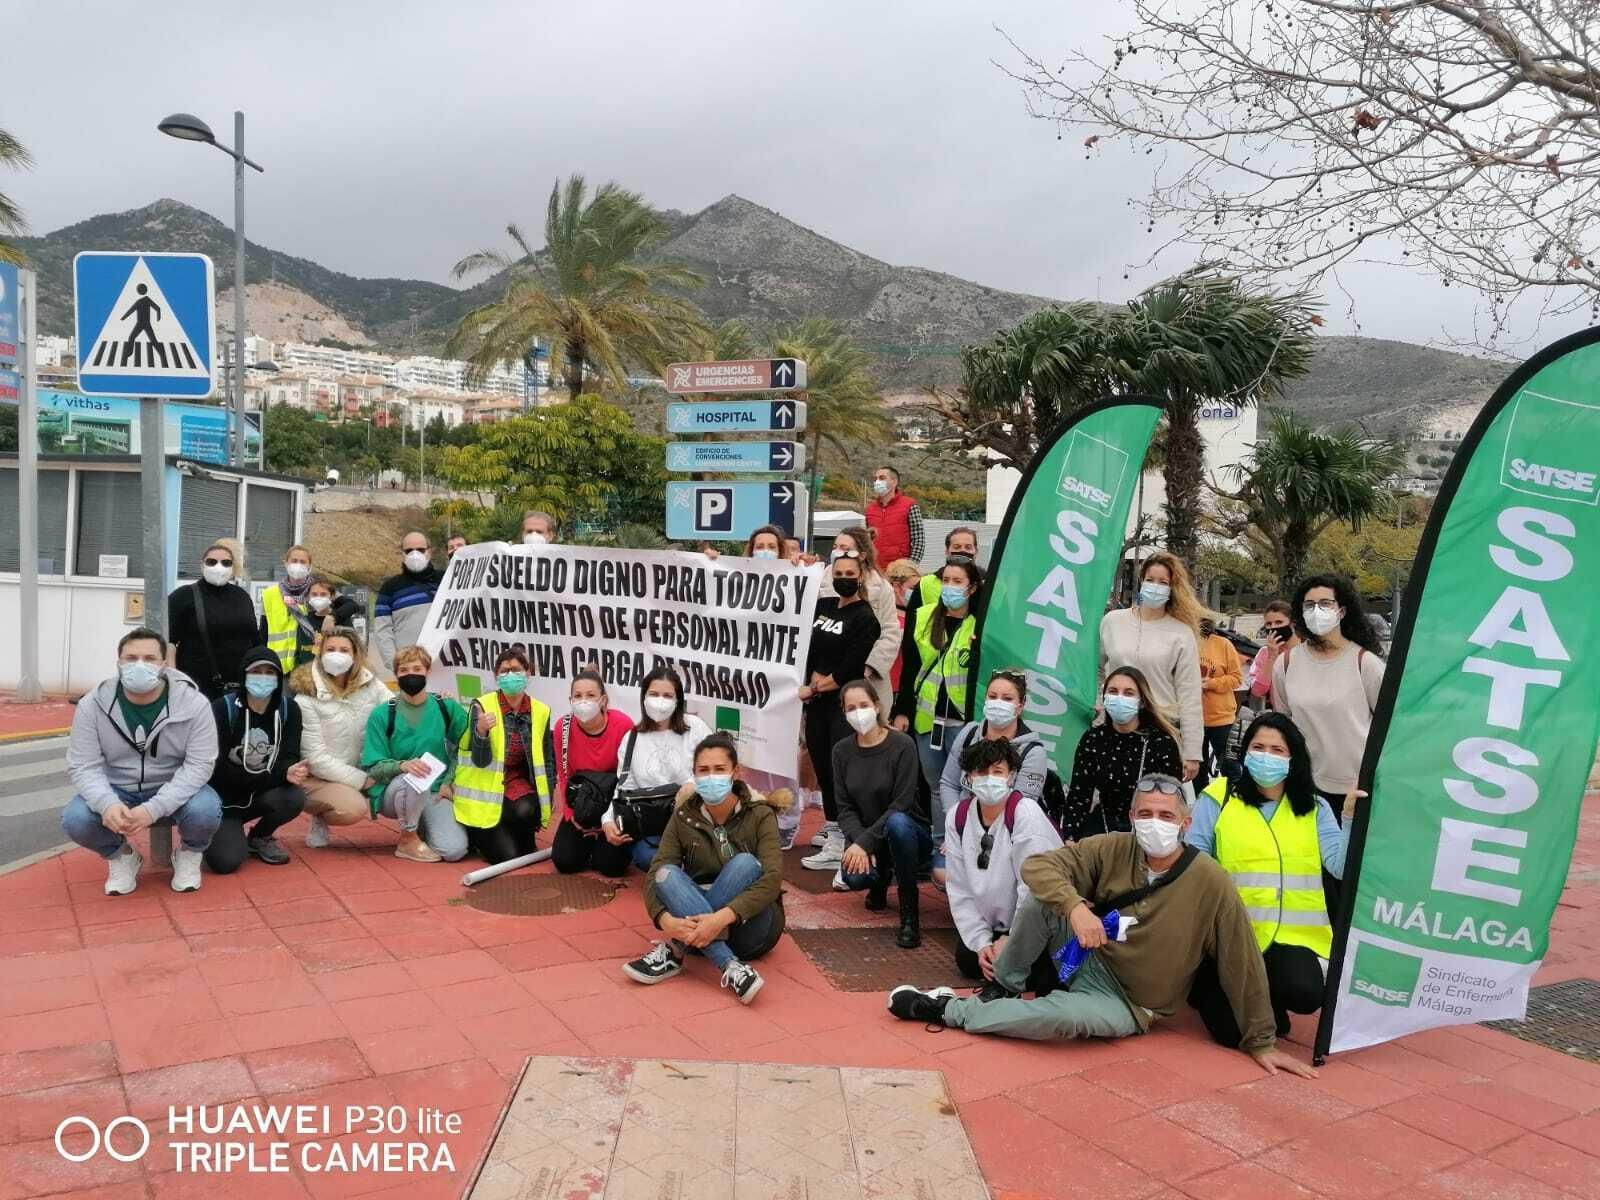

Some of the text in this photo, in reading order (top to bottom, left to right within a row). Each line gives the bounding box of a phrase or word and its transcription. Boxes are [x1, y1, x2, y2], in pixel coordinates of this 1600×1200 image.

[696, 365, 754, 376] URGENCIAS
[696, 376, 763, 386] EMERGENCIES
[65, 397, 110, 411] vithas
[1202, 405, 1238, 418] onal
[697, 411, 756, 423] HOSPITAL
[1509, 458, 1597, 493] SATSE
[1062, 476, 1111, 508] SATSE
[701, 493, 727, 527] P
[449, 558, 475, 590] POR
[487, 553, 568, 594] SUELDO
[573, 559, 647, 599] DIGNO
[652, 564, 707, 605] PARA
[713, 570, 788, 614] TODOS
[794, 575, 808, 615] Y
[459, 597, 487, 630] UN
[491, 598, 595, 638] AUMENTO
[600, 606, 629, 641] DE
[634, 608, 740, 657] PERSONAL
[744, 621, 800, 666] ANTE
[813, 615, 843, 635] FILA
[438, 638, 468, 667] LA
[468, 637, 566, 679] EXCIVA
[679, 658, 770, 709] TRABAJO
[1431, 506, 1576, 907] SATSE
[1372, 896, 1533, 951] MÁLAGA
[1422, 982, 1441, 994] de
[1427, 966, 1496, 989] Sindicato
[1354, 979, 1410, 1002] SATSE
[1418, 996, 1473, 1017] Málaga
